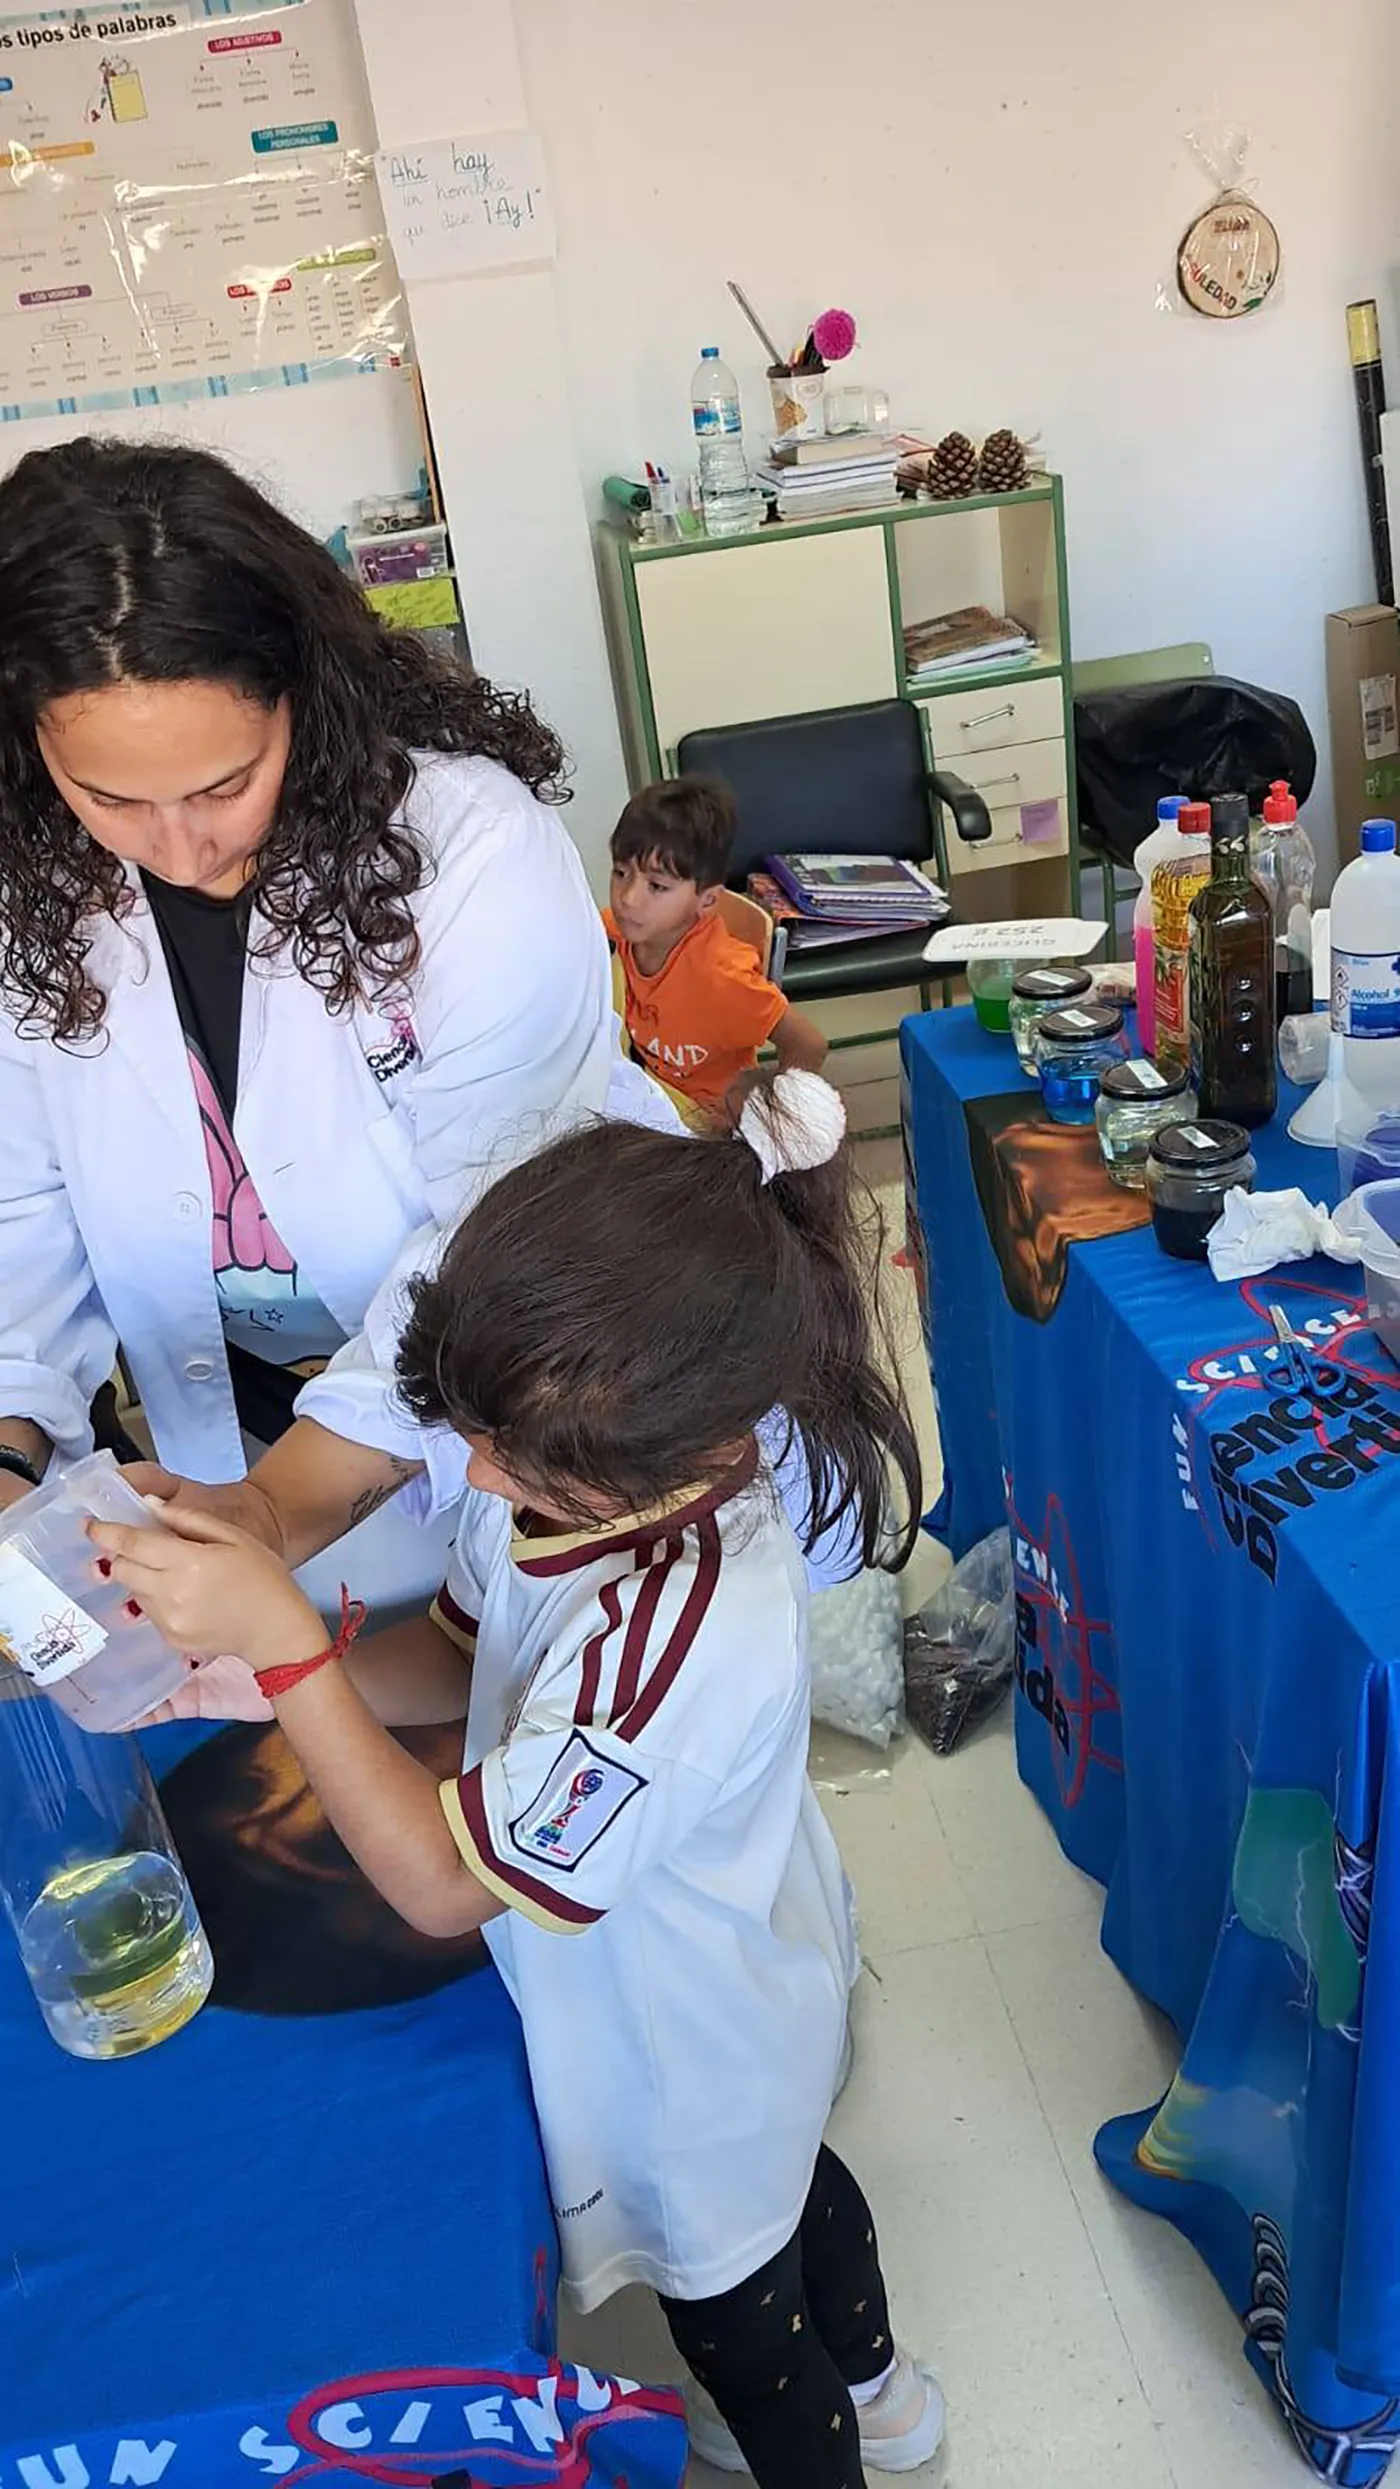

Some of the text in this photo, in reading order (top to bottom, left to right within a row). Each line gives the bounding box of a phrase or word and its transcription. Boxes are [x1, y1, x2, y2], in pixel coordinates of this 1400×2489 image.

[0, 13, 177, 49] s tipos de palabras
[450, 141, 494, 182] hay
[1351, 988, 1390, 1000] Alcohol
[1210, 1374, 1381, 1548] Ciencia
[0, 2438, 178, 2489] UN
